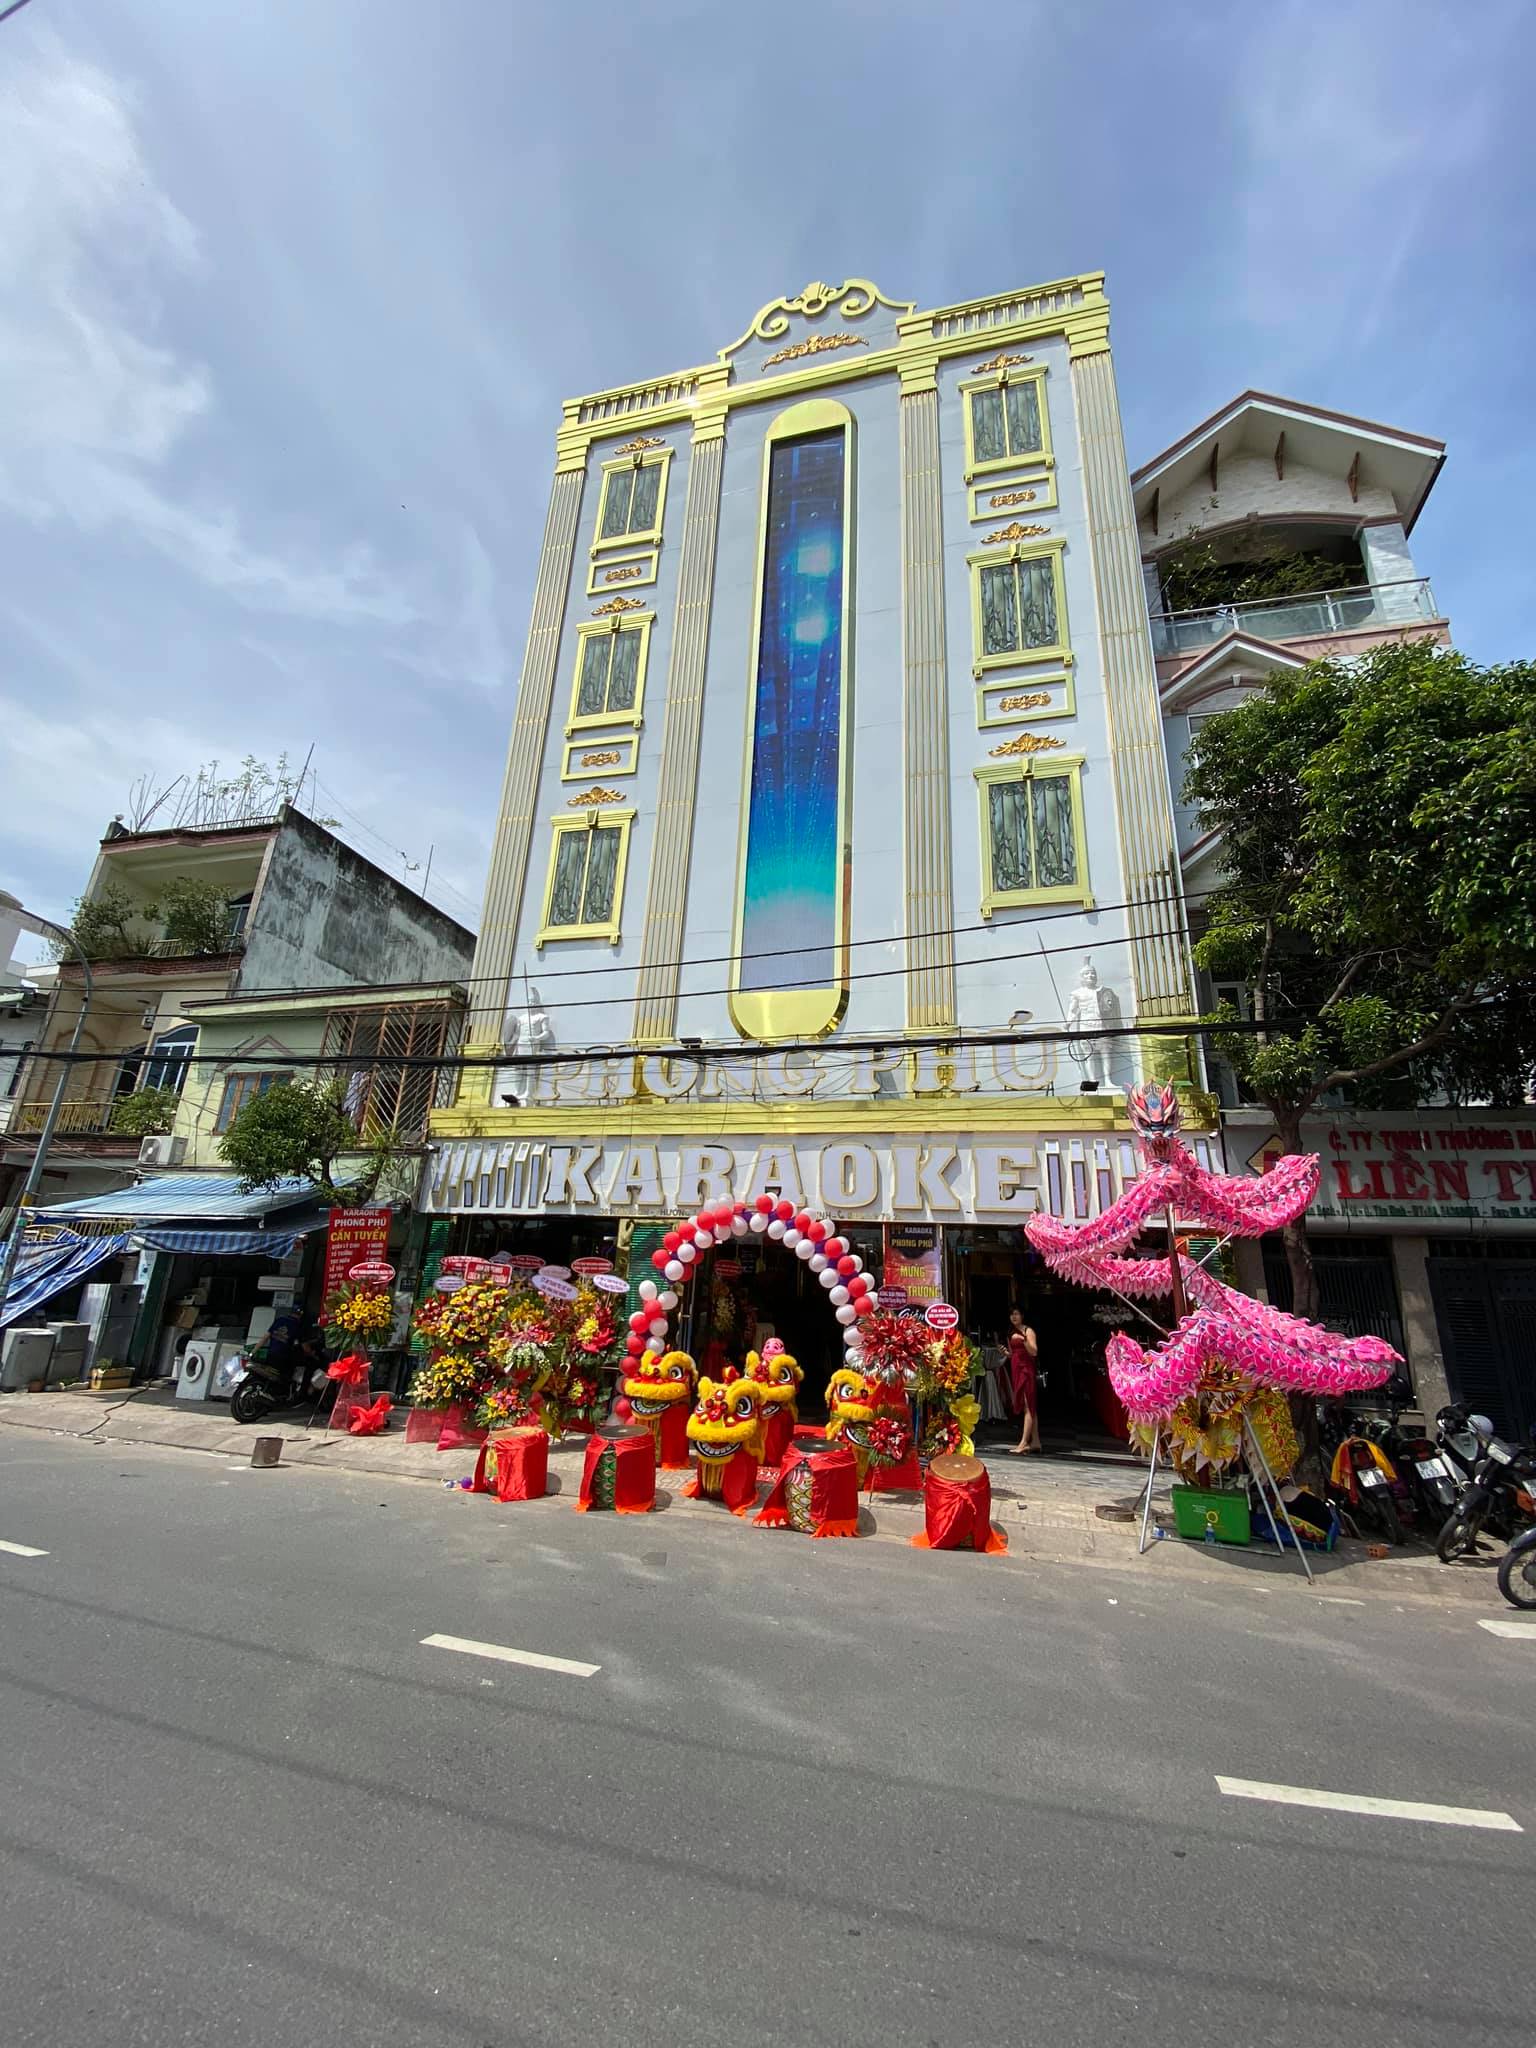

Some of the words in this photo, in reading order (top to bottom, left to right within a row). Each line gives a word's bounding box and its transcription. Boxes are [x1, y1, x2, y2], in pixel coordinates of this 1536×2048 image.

[534, 1040, 827, 1100] PHONG
[543, 1143, 1039, 1213] KARAOKE
[334, 1218, 365, 1227] PHONG
[891, 1238, 917, 1247] PHONG
